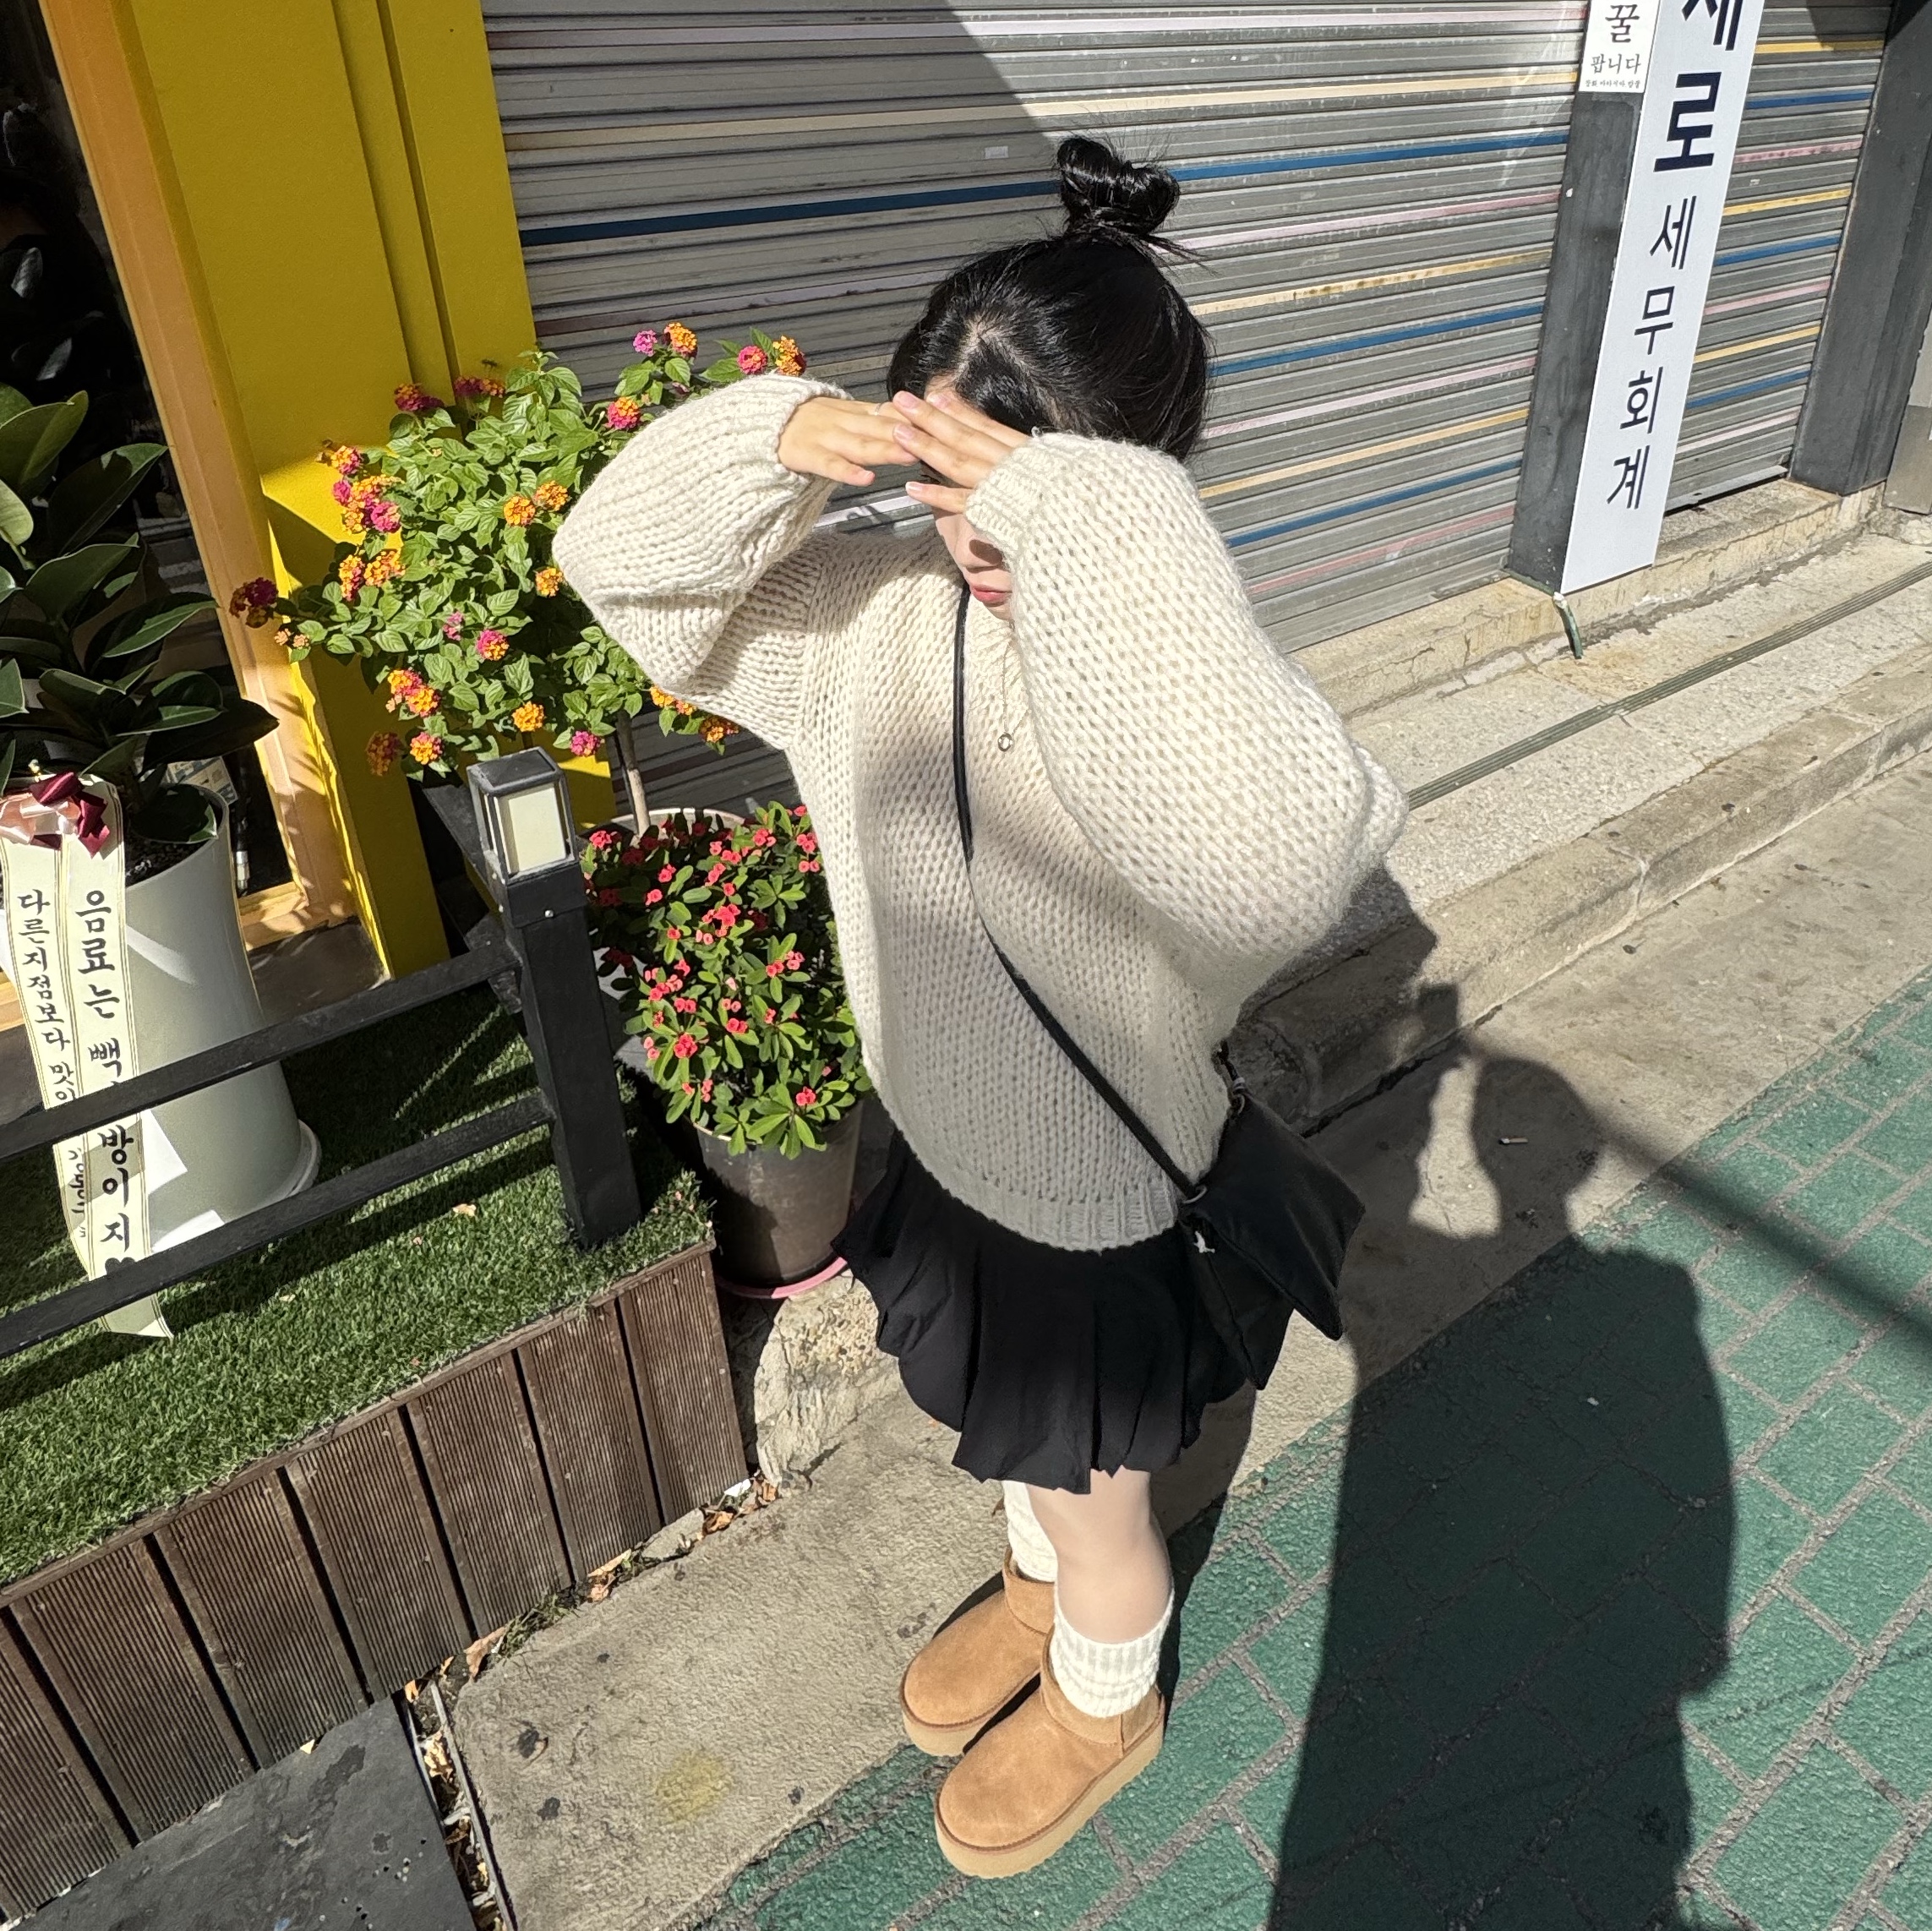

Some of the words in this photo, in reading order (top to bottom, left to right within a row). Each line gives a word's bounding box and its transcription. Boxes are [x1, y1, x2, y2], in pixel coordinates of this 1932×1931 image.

[1591, 53, 1641, 74] 팝니다
[1605, 4, 1640, 43] 꿀
[1607, 195, 1696, 509] 세무회계
[74, 890, 120, 1019] 음료는
